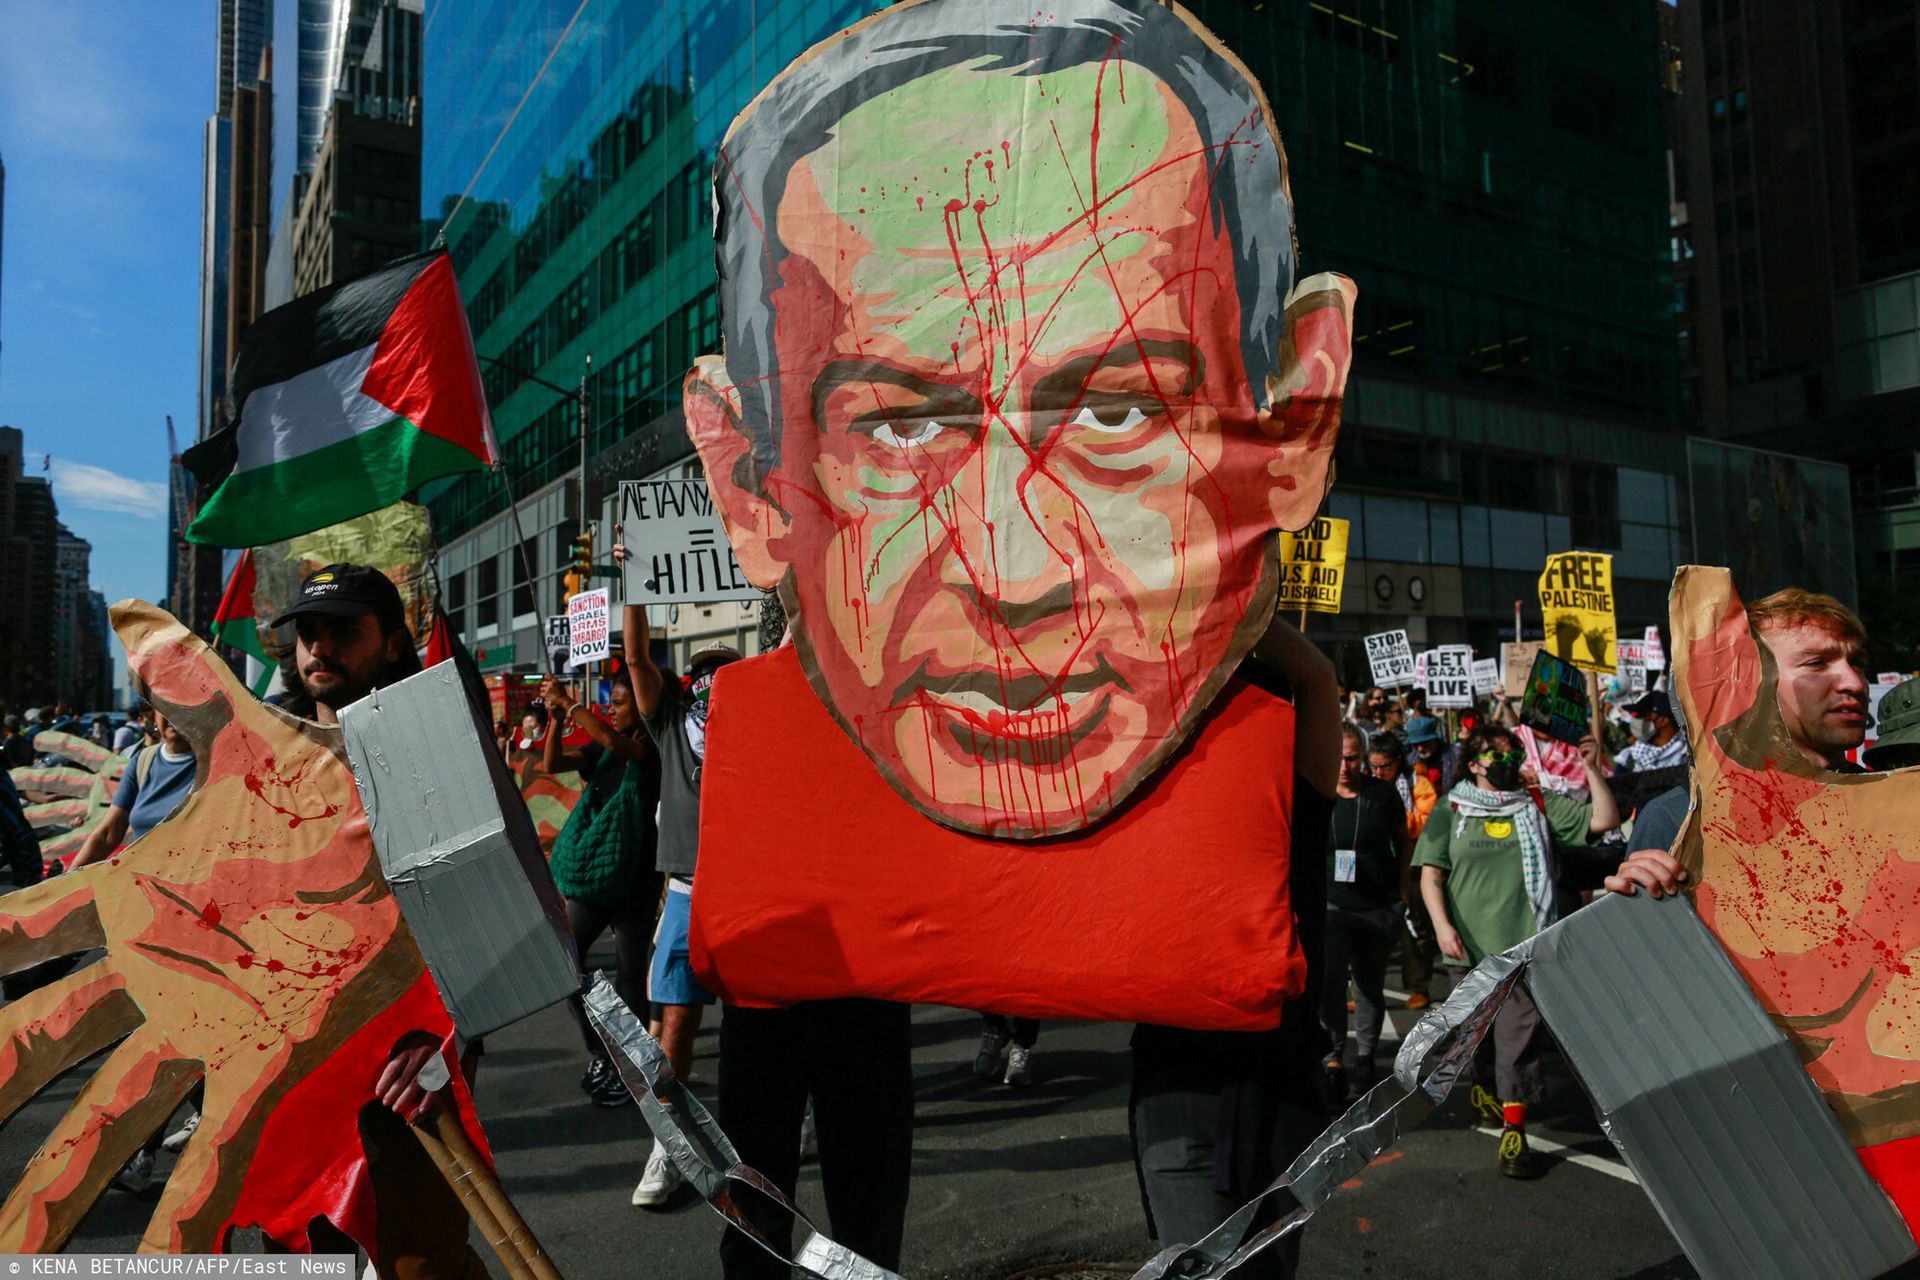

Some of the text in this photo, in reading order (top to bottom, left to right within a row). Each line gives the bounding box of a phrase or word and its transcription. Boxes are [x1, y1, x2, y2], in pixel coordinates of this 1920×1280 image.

[1293, 541, 1325, 562] ALL
[652, 547, 753, 595] HITLE
[1311, 567, 1338, 586] AID
[1546, 555, 1605, 592] FREE
[315, 583, 339, 592] open
[1291, 585, 1336, 602] ISRAEL!
[570, 596, 606, 615] SANCTION
[1541, 591, 1612, 612] PALESTINE
[571, 609, 606, 623] ISRAEL
[572, 617, 606, 632] ARMS
[572, 628, 607, 646] EMBARGO
[1367, 632, 1403, 649] STOP
[572, 640, 607, 658] NOW
[1370, 644, 1408, 657] KILLING
[1373, 657, 1411, 671] LET GAZA
[1427, 652, 1466, 666] LET
[1375, 665, 1413, 678] LIVE
[1427, 667, 1467, 677] GAZA
[1429, 680, 1468, 696] LIVE
[1469, 839, 1495, 848] HAPPY
